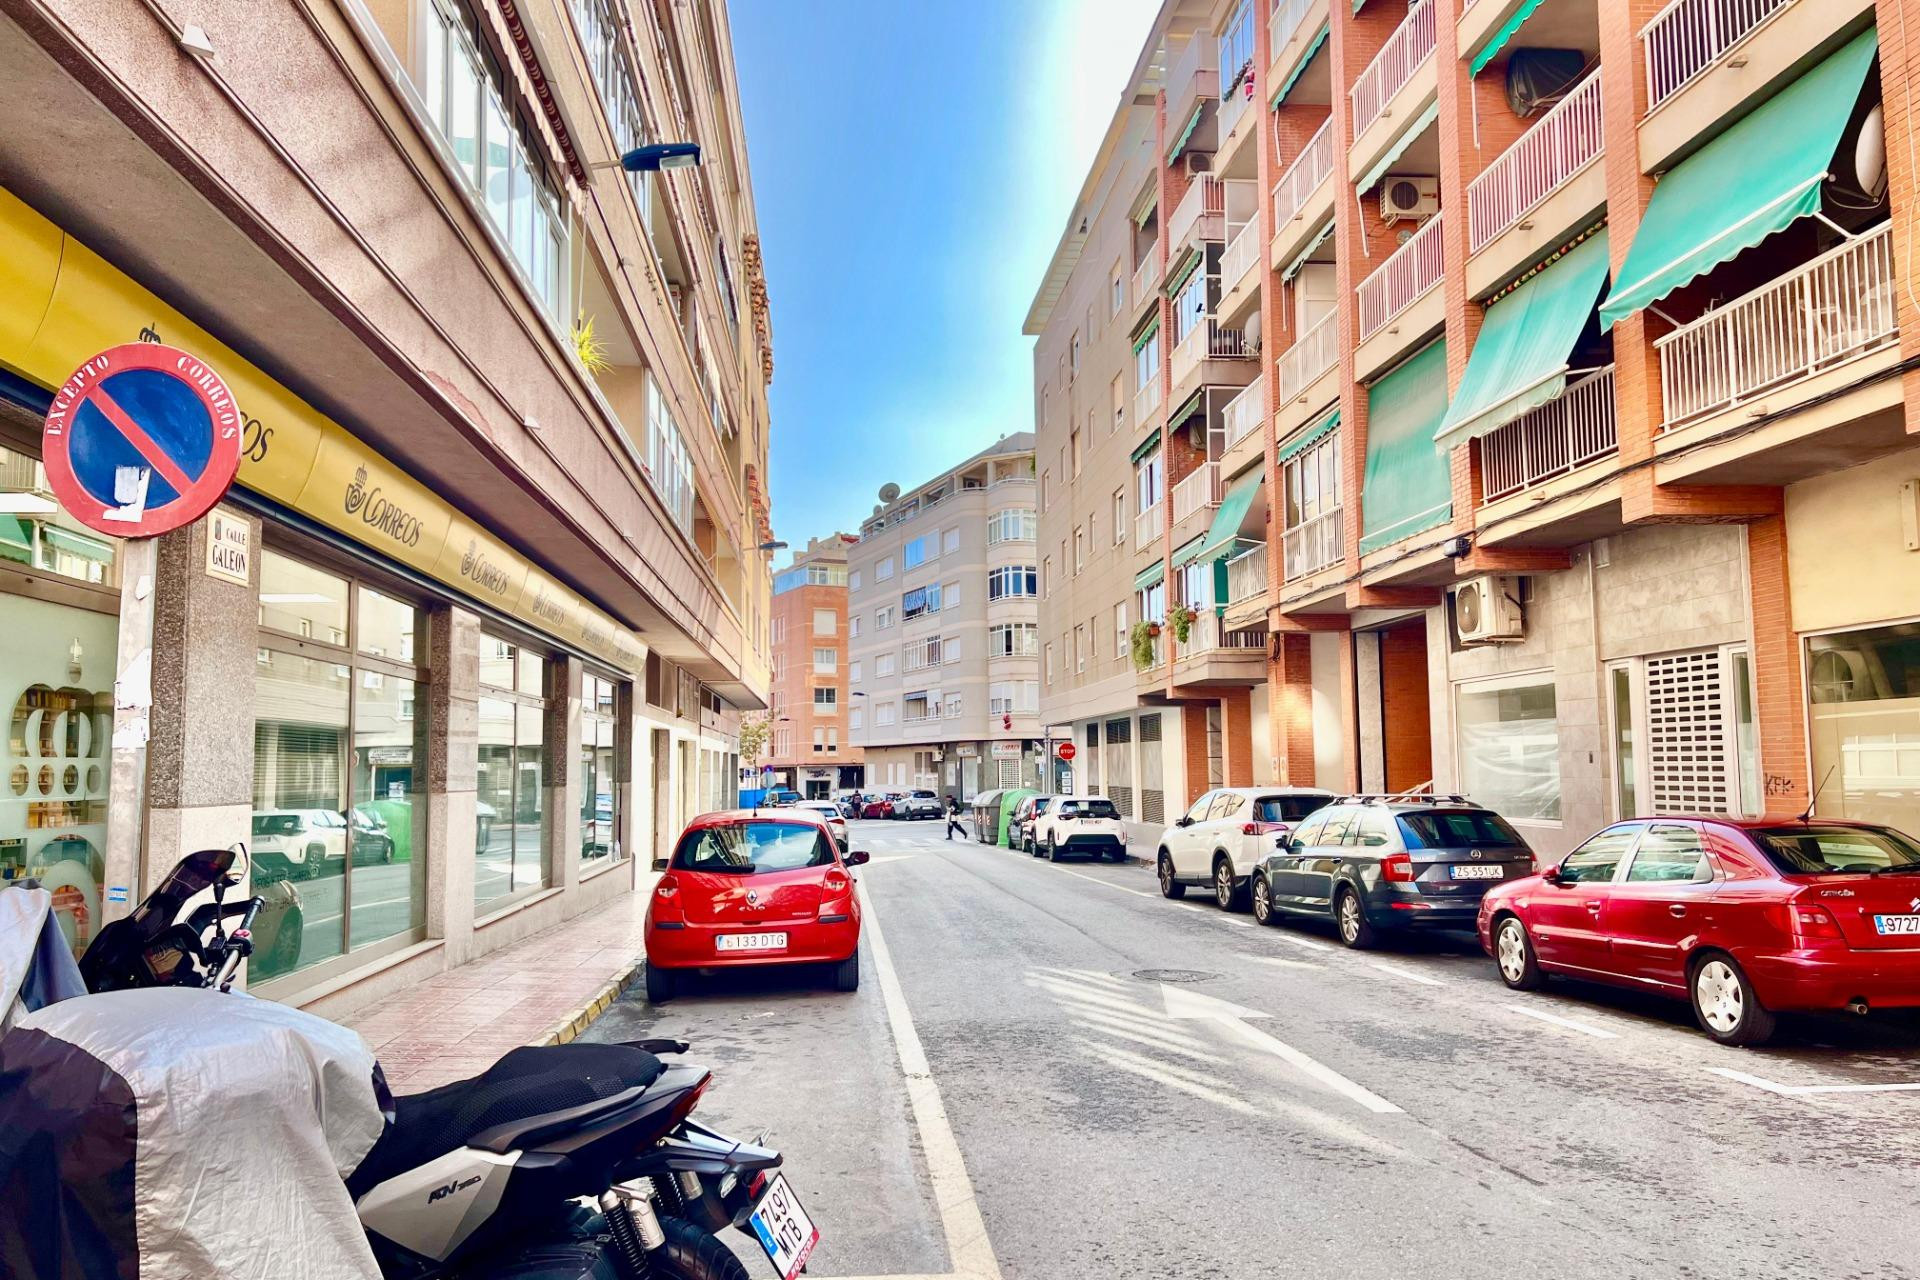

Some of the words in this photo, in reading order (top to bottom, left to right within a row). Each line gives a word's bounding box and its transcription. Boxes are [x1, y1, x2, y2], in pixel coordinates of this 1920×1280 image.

[47, 356, 109, 435] EXCEPTO
[177, 356, 237, 439] CORREOS
[240, 410, 274, 462] OS
[226, 527, 246, 546] CALLE
[363, 487, 424, 547] CORREOS
[471, 553, 510, 596] CORREOS
[761, 934, 784, 947] DTG
[1886, 917, 1919, 932] 9727
[760, 1183, 791, 1235] 7497
[776, 1217, 802, 1260] MTB
